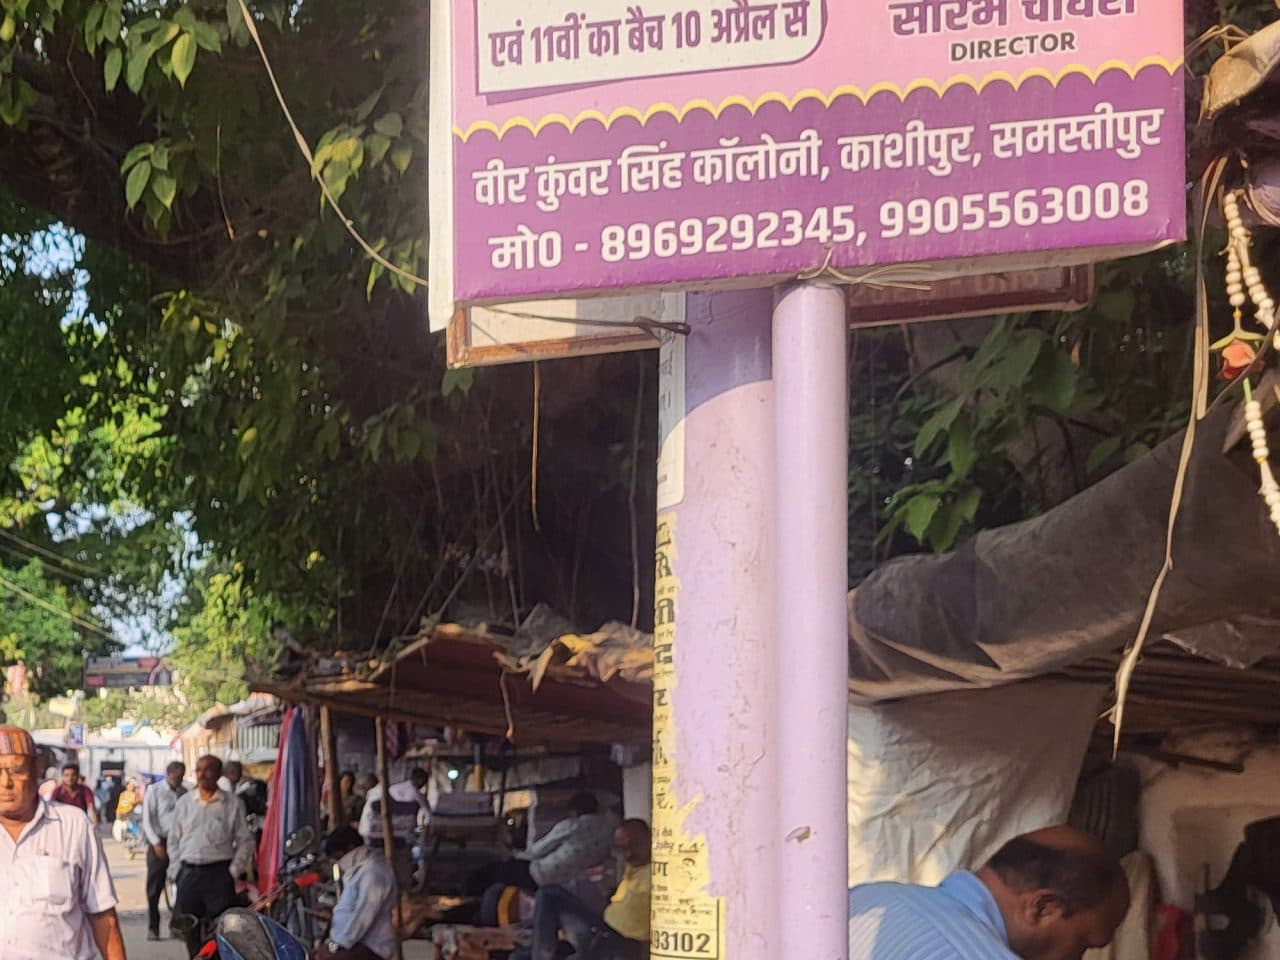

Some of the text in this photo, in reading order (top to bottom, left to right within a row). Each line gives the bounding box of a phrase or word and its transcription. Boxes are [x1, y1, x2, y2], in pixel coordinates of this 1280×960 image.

[488, 20, 525, 67] एवं
[530, 12, 586, 63] 11वीं
[586, 18, 621, 57] का
[625, 6, 665, 52] बैच
[671, 10, 702, 49] 10
[782, 0, 811, 37] स
[950, 31, 1076, 62] DIRECTOR
[472, 102, 1165, 212] वीर कुंवर सिंह कॉलोनी, काशीपुर, समस्तीपुर
[600, 204, 867, 263] 8969292345,
[879, 178, 1149, 239] 9905563008
